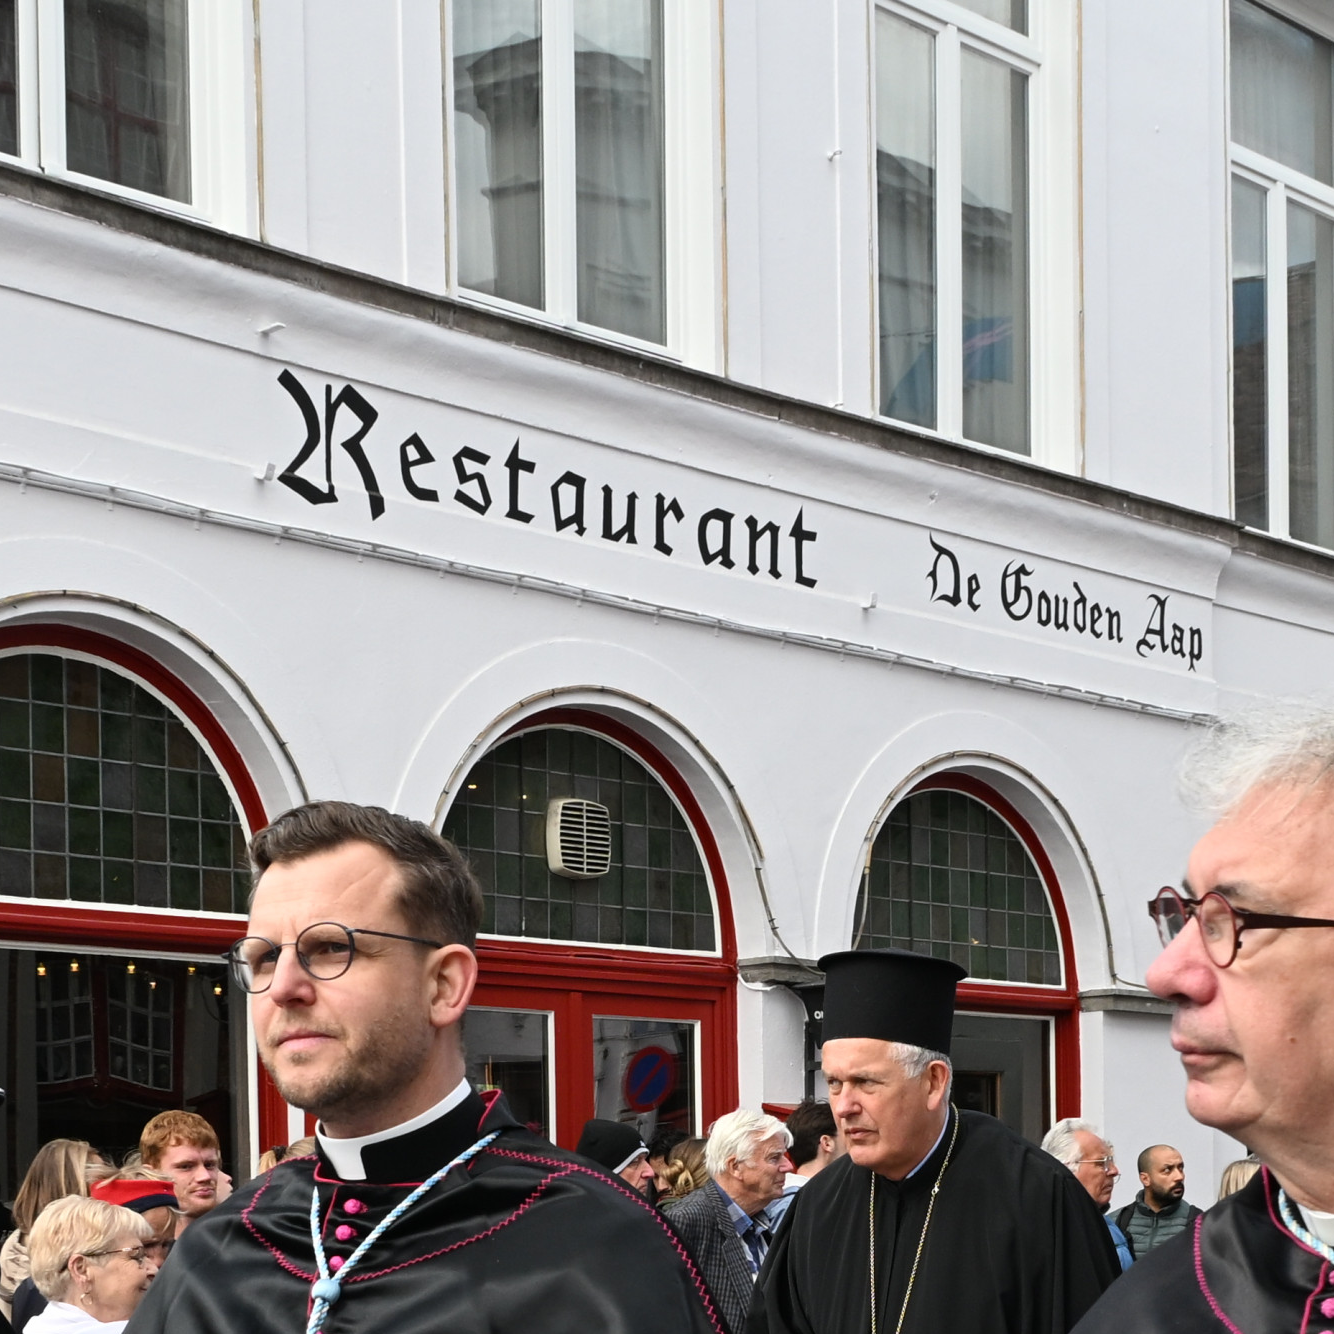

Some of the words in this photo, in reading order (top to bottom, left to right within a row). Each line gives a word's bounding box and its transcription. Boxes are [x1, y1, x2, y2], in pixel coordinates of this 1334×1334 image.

[276, 368, 819, 589] Restaurant
[925, 530, 982, 613] De
[1000, 558, 1124, 644] Gouden
[1135, 593, 1203, 673] Aap
